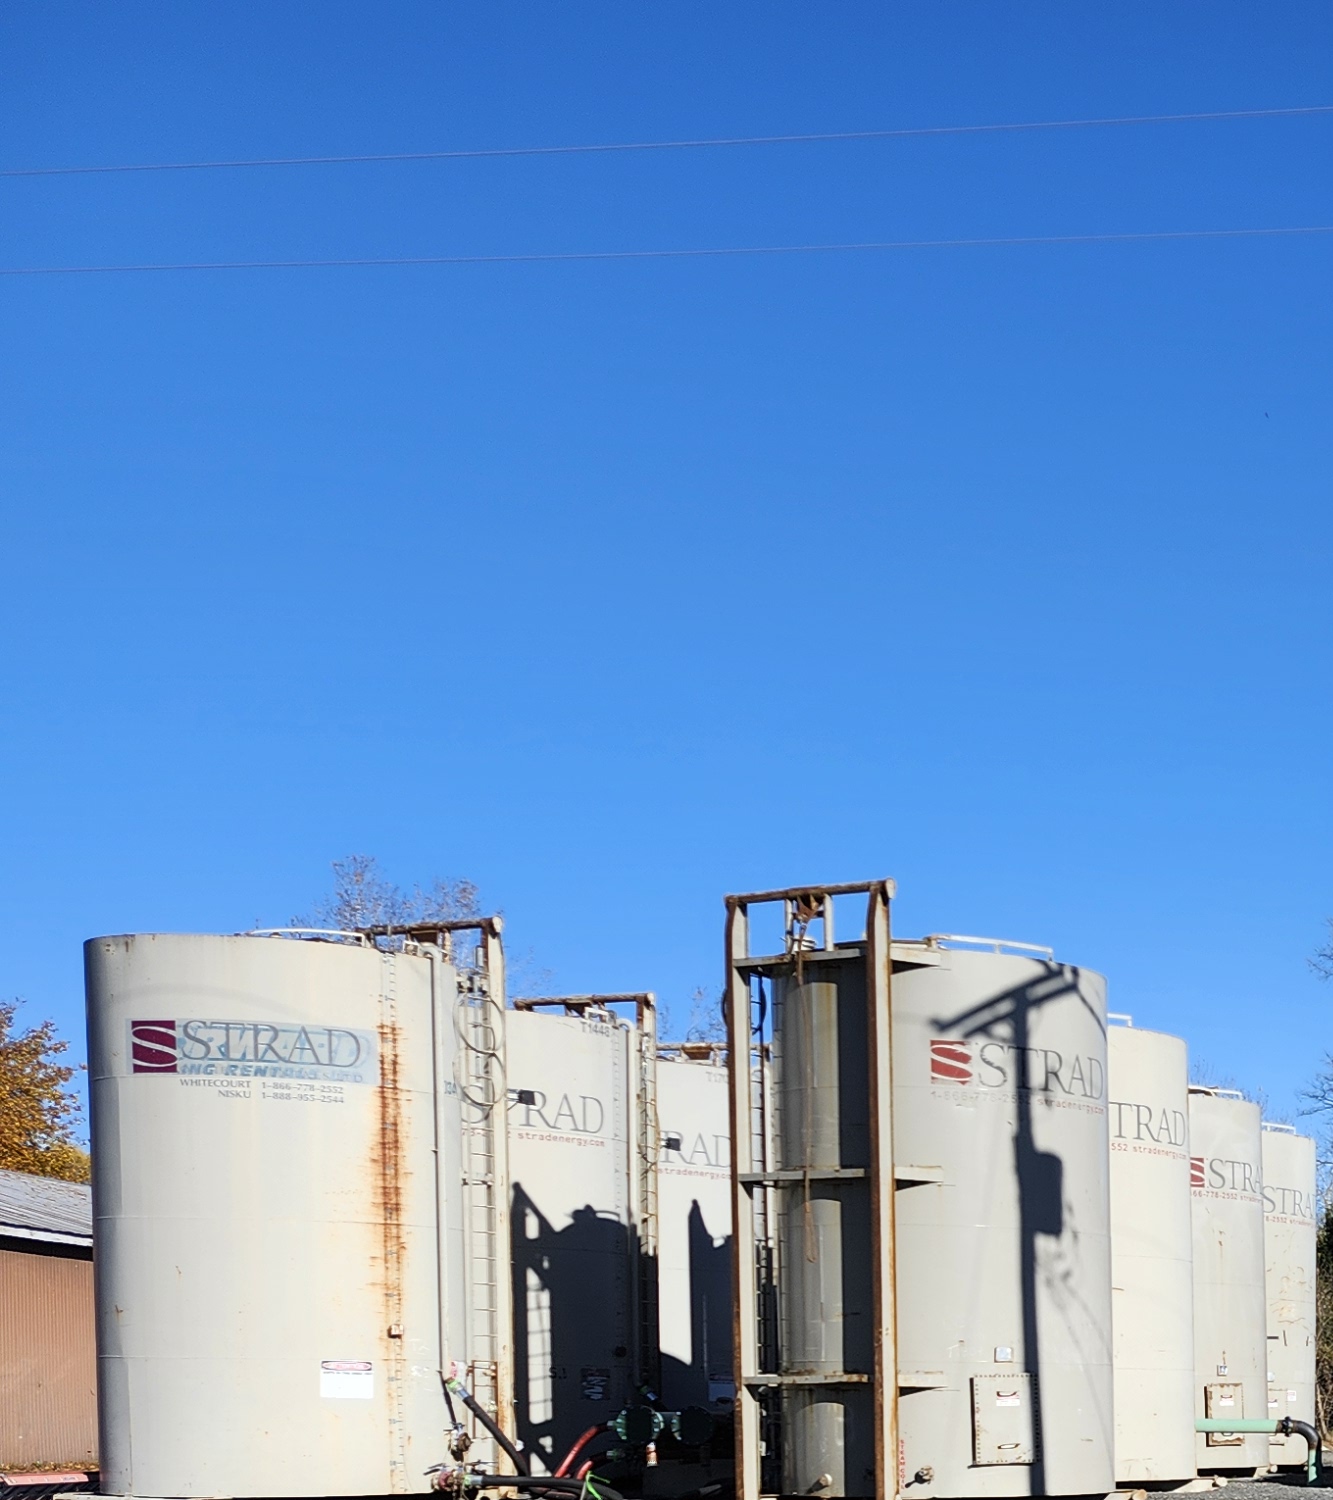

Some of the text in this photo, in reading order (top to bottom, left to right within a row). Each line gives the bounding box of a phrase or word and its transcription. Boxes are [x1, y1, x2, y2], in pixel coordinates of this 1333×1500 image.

[182, 1020, 361, 1068] STRAD
[180, 1078, 252, 1090] WHITECOURT
[978, 1043, 1104, 1100] STRAD
[217, 1090, 252, 1099] NISKU
[1261, 1185, 1317, 1221] STRA
